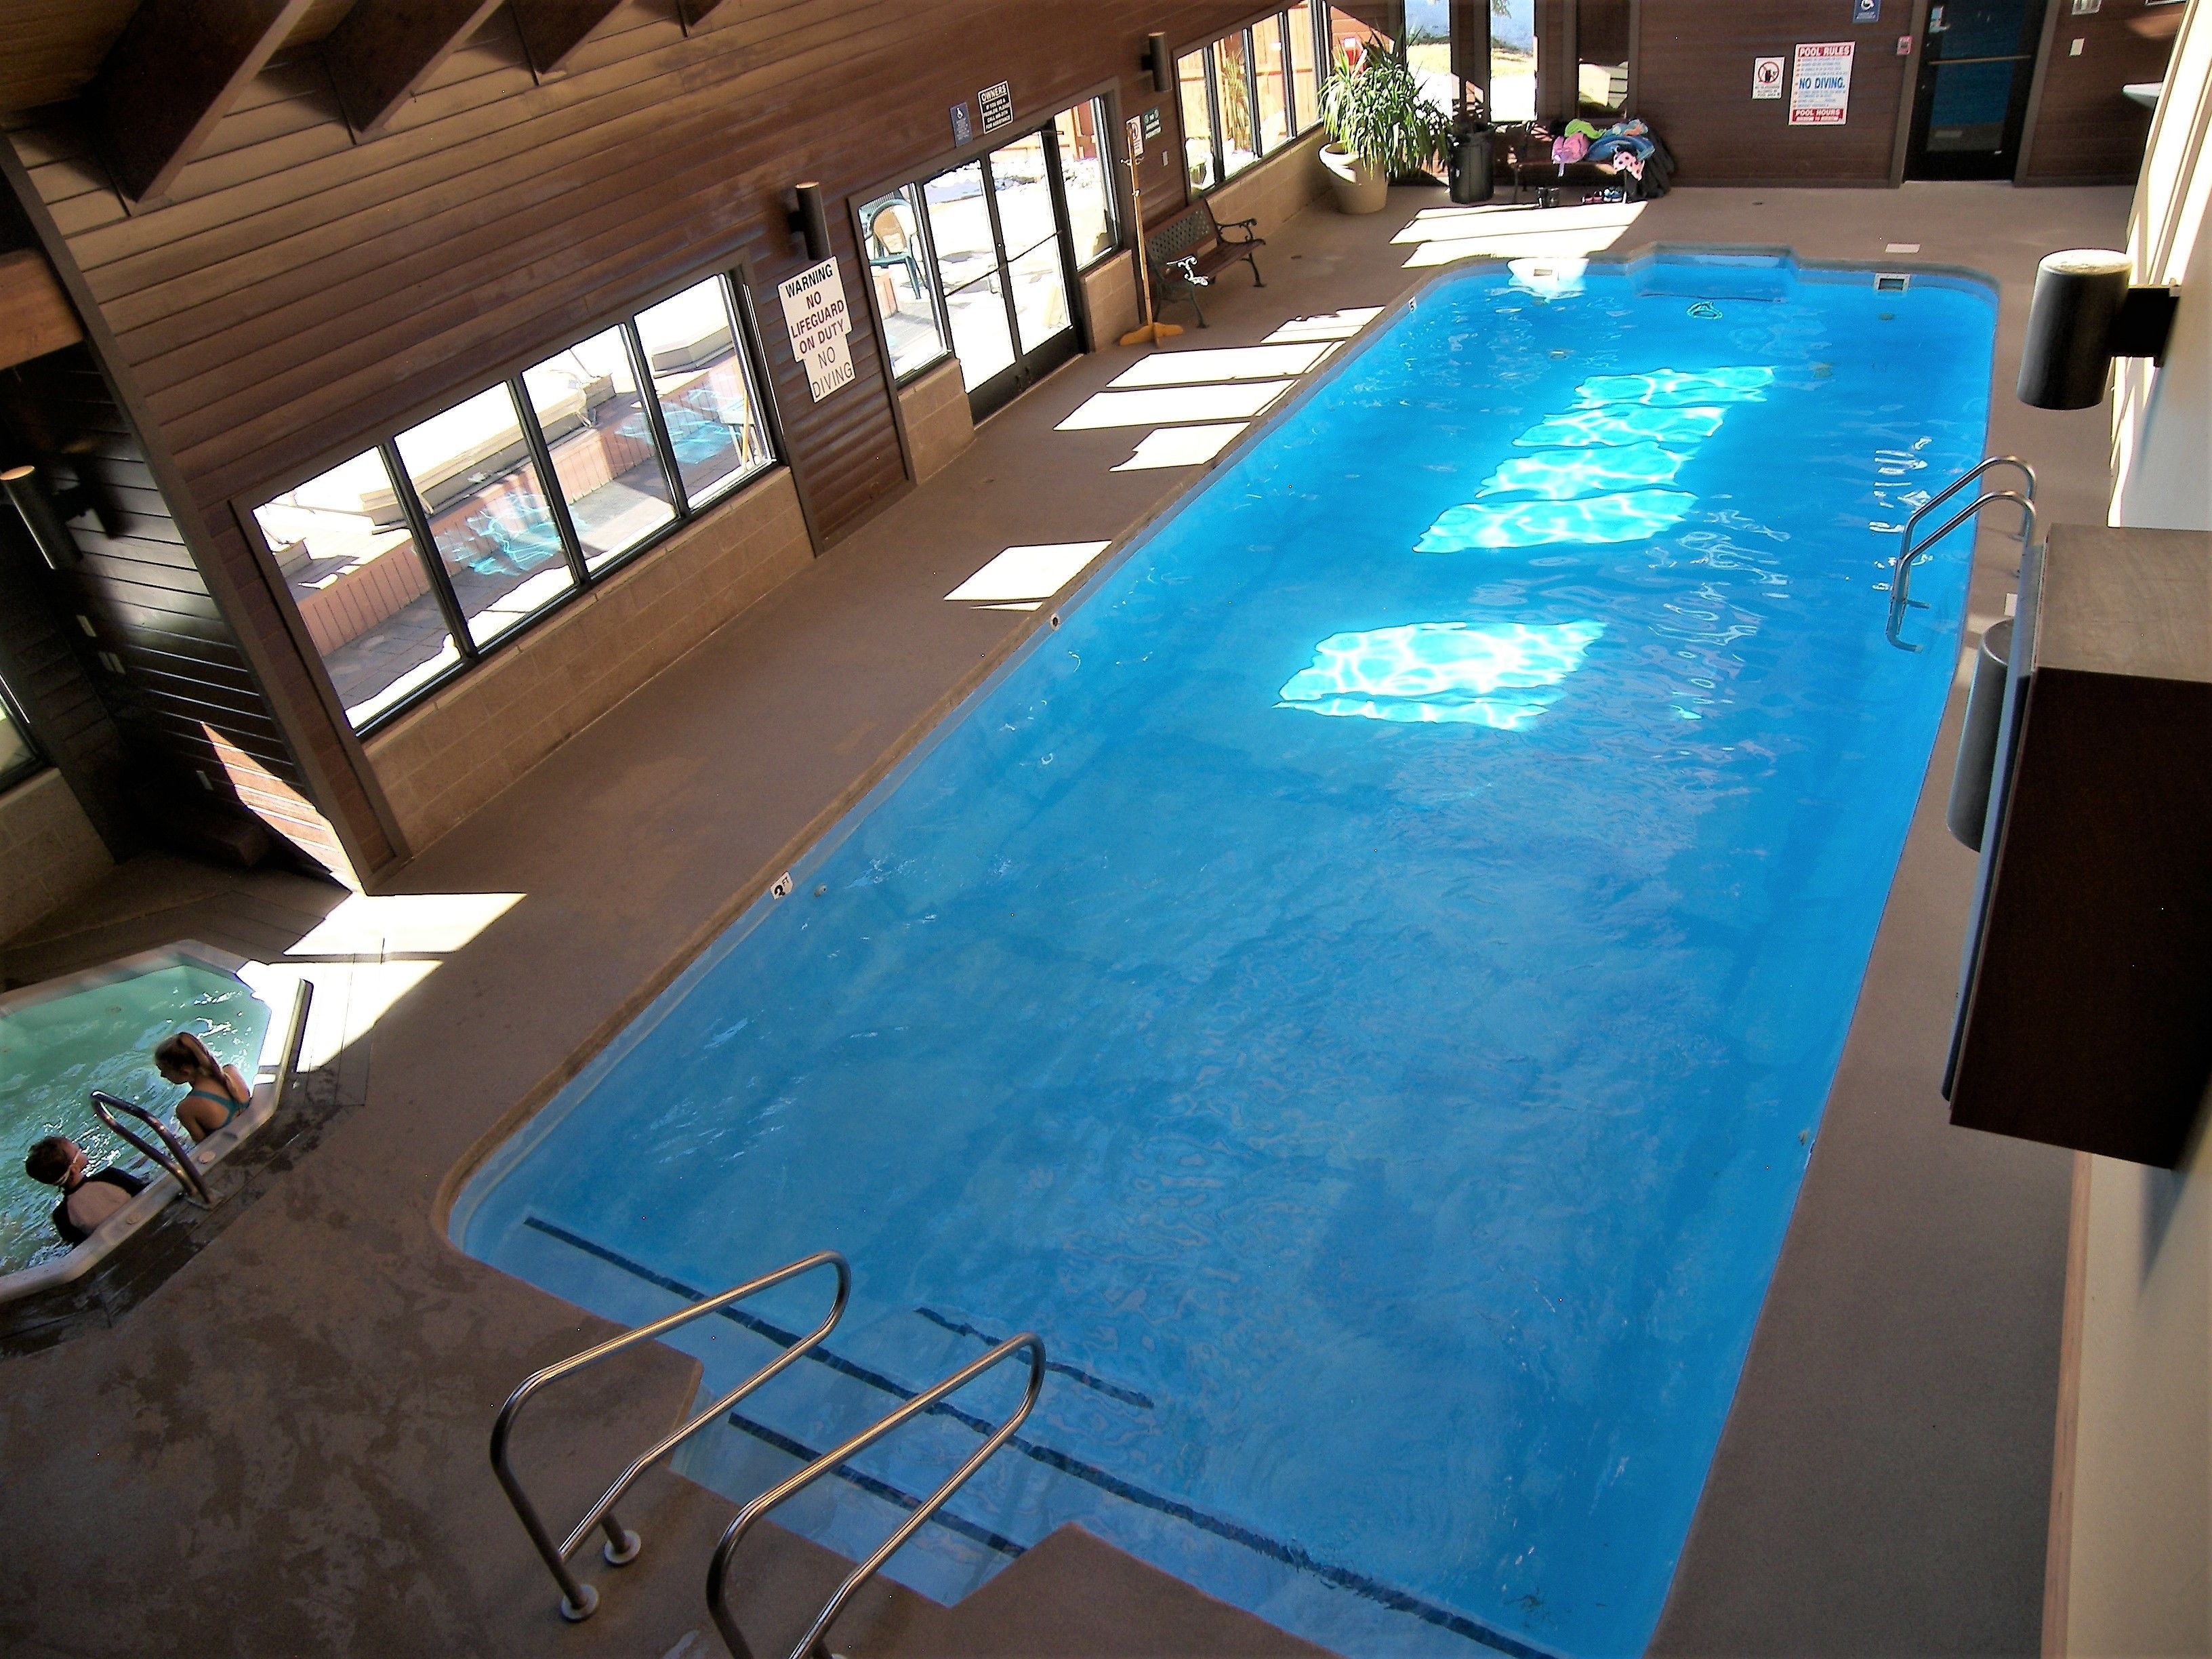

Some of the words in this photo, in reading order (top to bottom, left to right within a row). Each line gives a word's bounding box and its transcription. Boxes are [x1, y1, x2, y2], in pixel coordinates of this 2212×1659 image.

[1799, 47, 1821, 57] POOL
[1822, 45, 1851, 56] RULES
[981, 85, 1006, 102] OWNERS
[1799, 77, 1811, 89] NO
[1816, 108, 1841, 117] HOURS
[785, 264, 833, 298] WARNING
[806, 291, 821, 310] NO
[791, 300, 844, 338] LIFEGUARD
[799, 335, 815, 354] ON
[818, 319, 844, 344] DUTY
[817, 346, 836, 369] NO
[812, 362, 853, 398] DIVING
